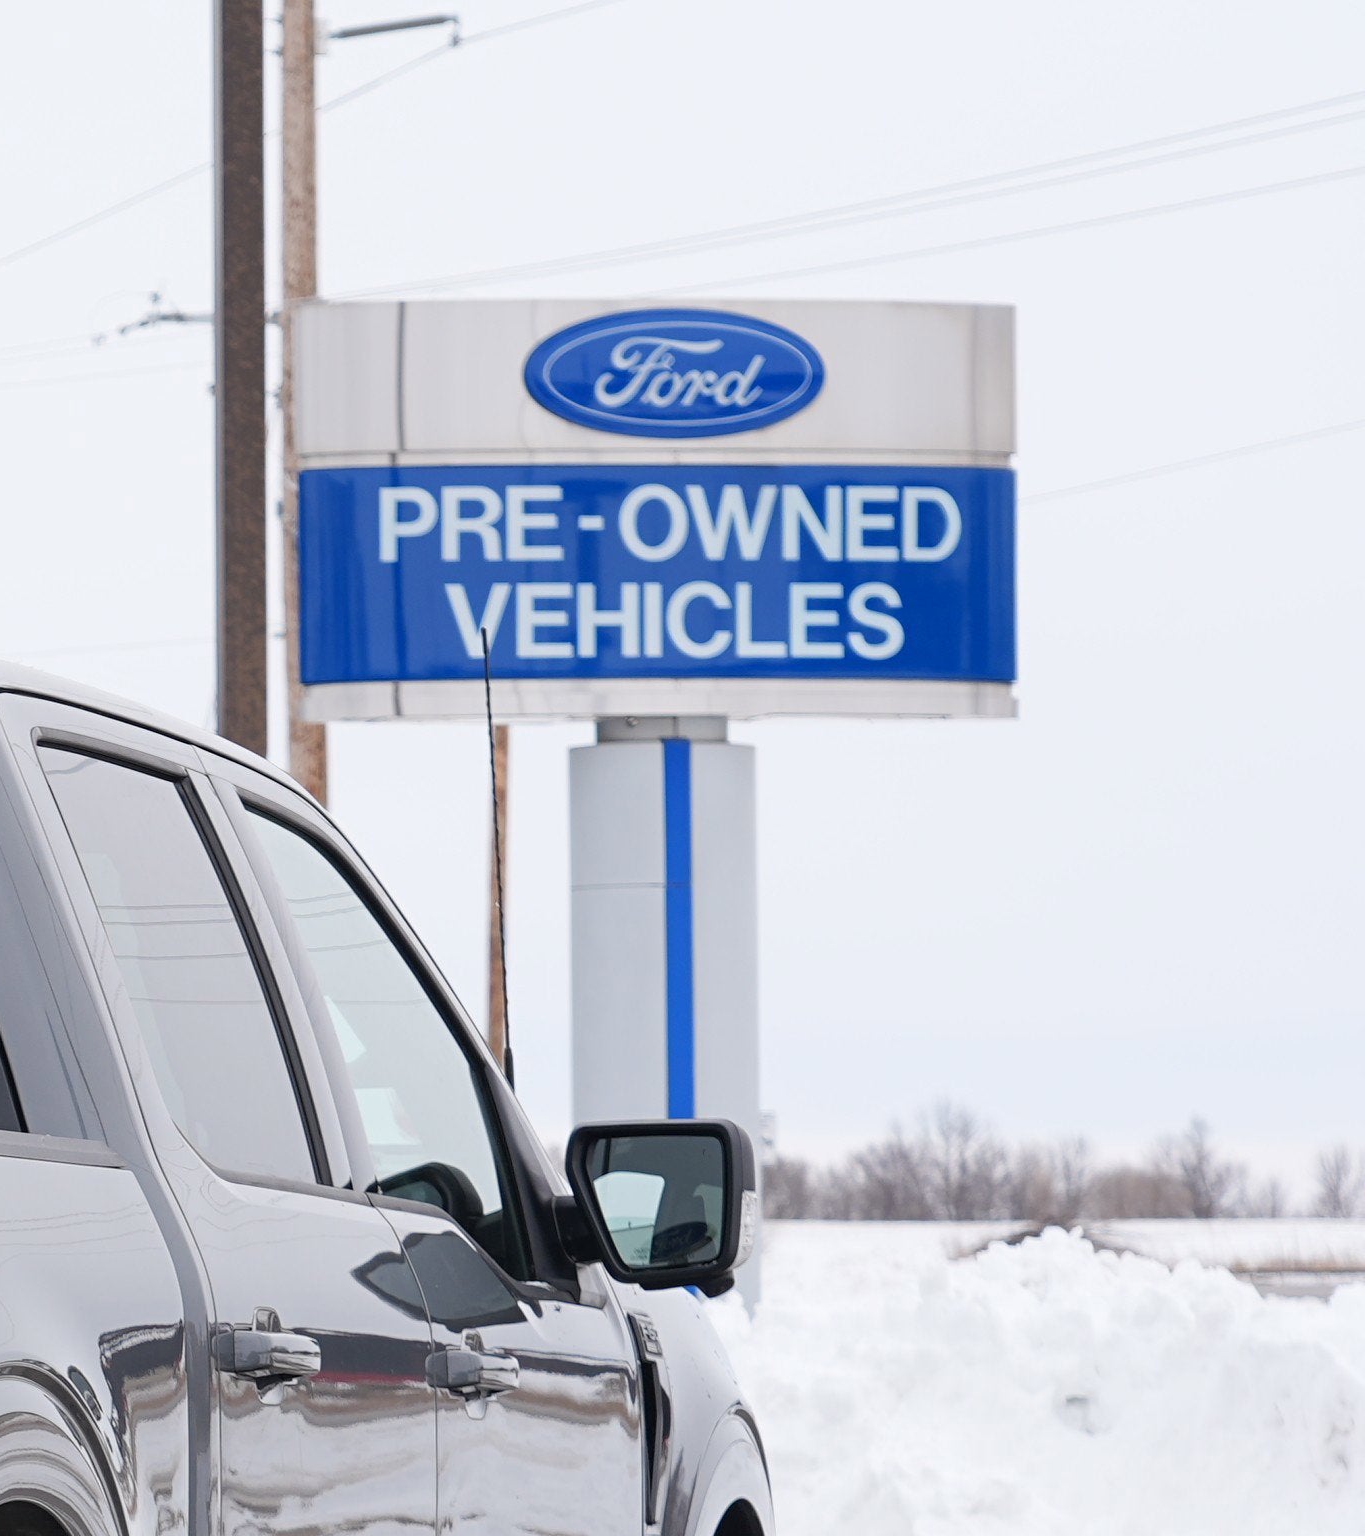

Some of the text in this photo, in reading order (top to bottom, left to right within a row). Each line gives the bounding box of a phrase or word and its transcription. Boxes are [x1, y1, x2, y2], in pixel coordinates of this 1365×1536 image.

[593, 335, 764, 408] Ford
[378, 482, 963, 563] PRE-OWNED
[443, 581, 906, 660] VEHICLES
